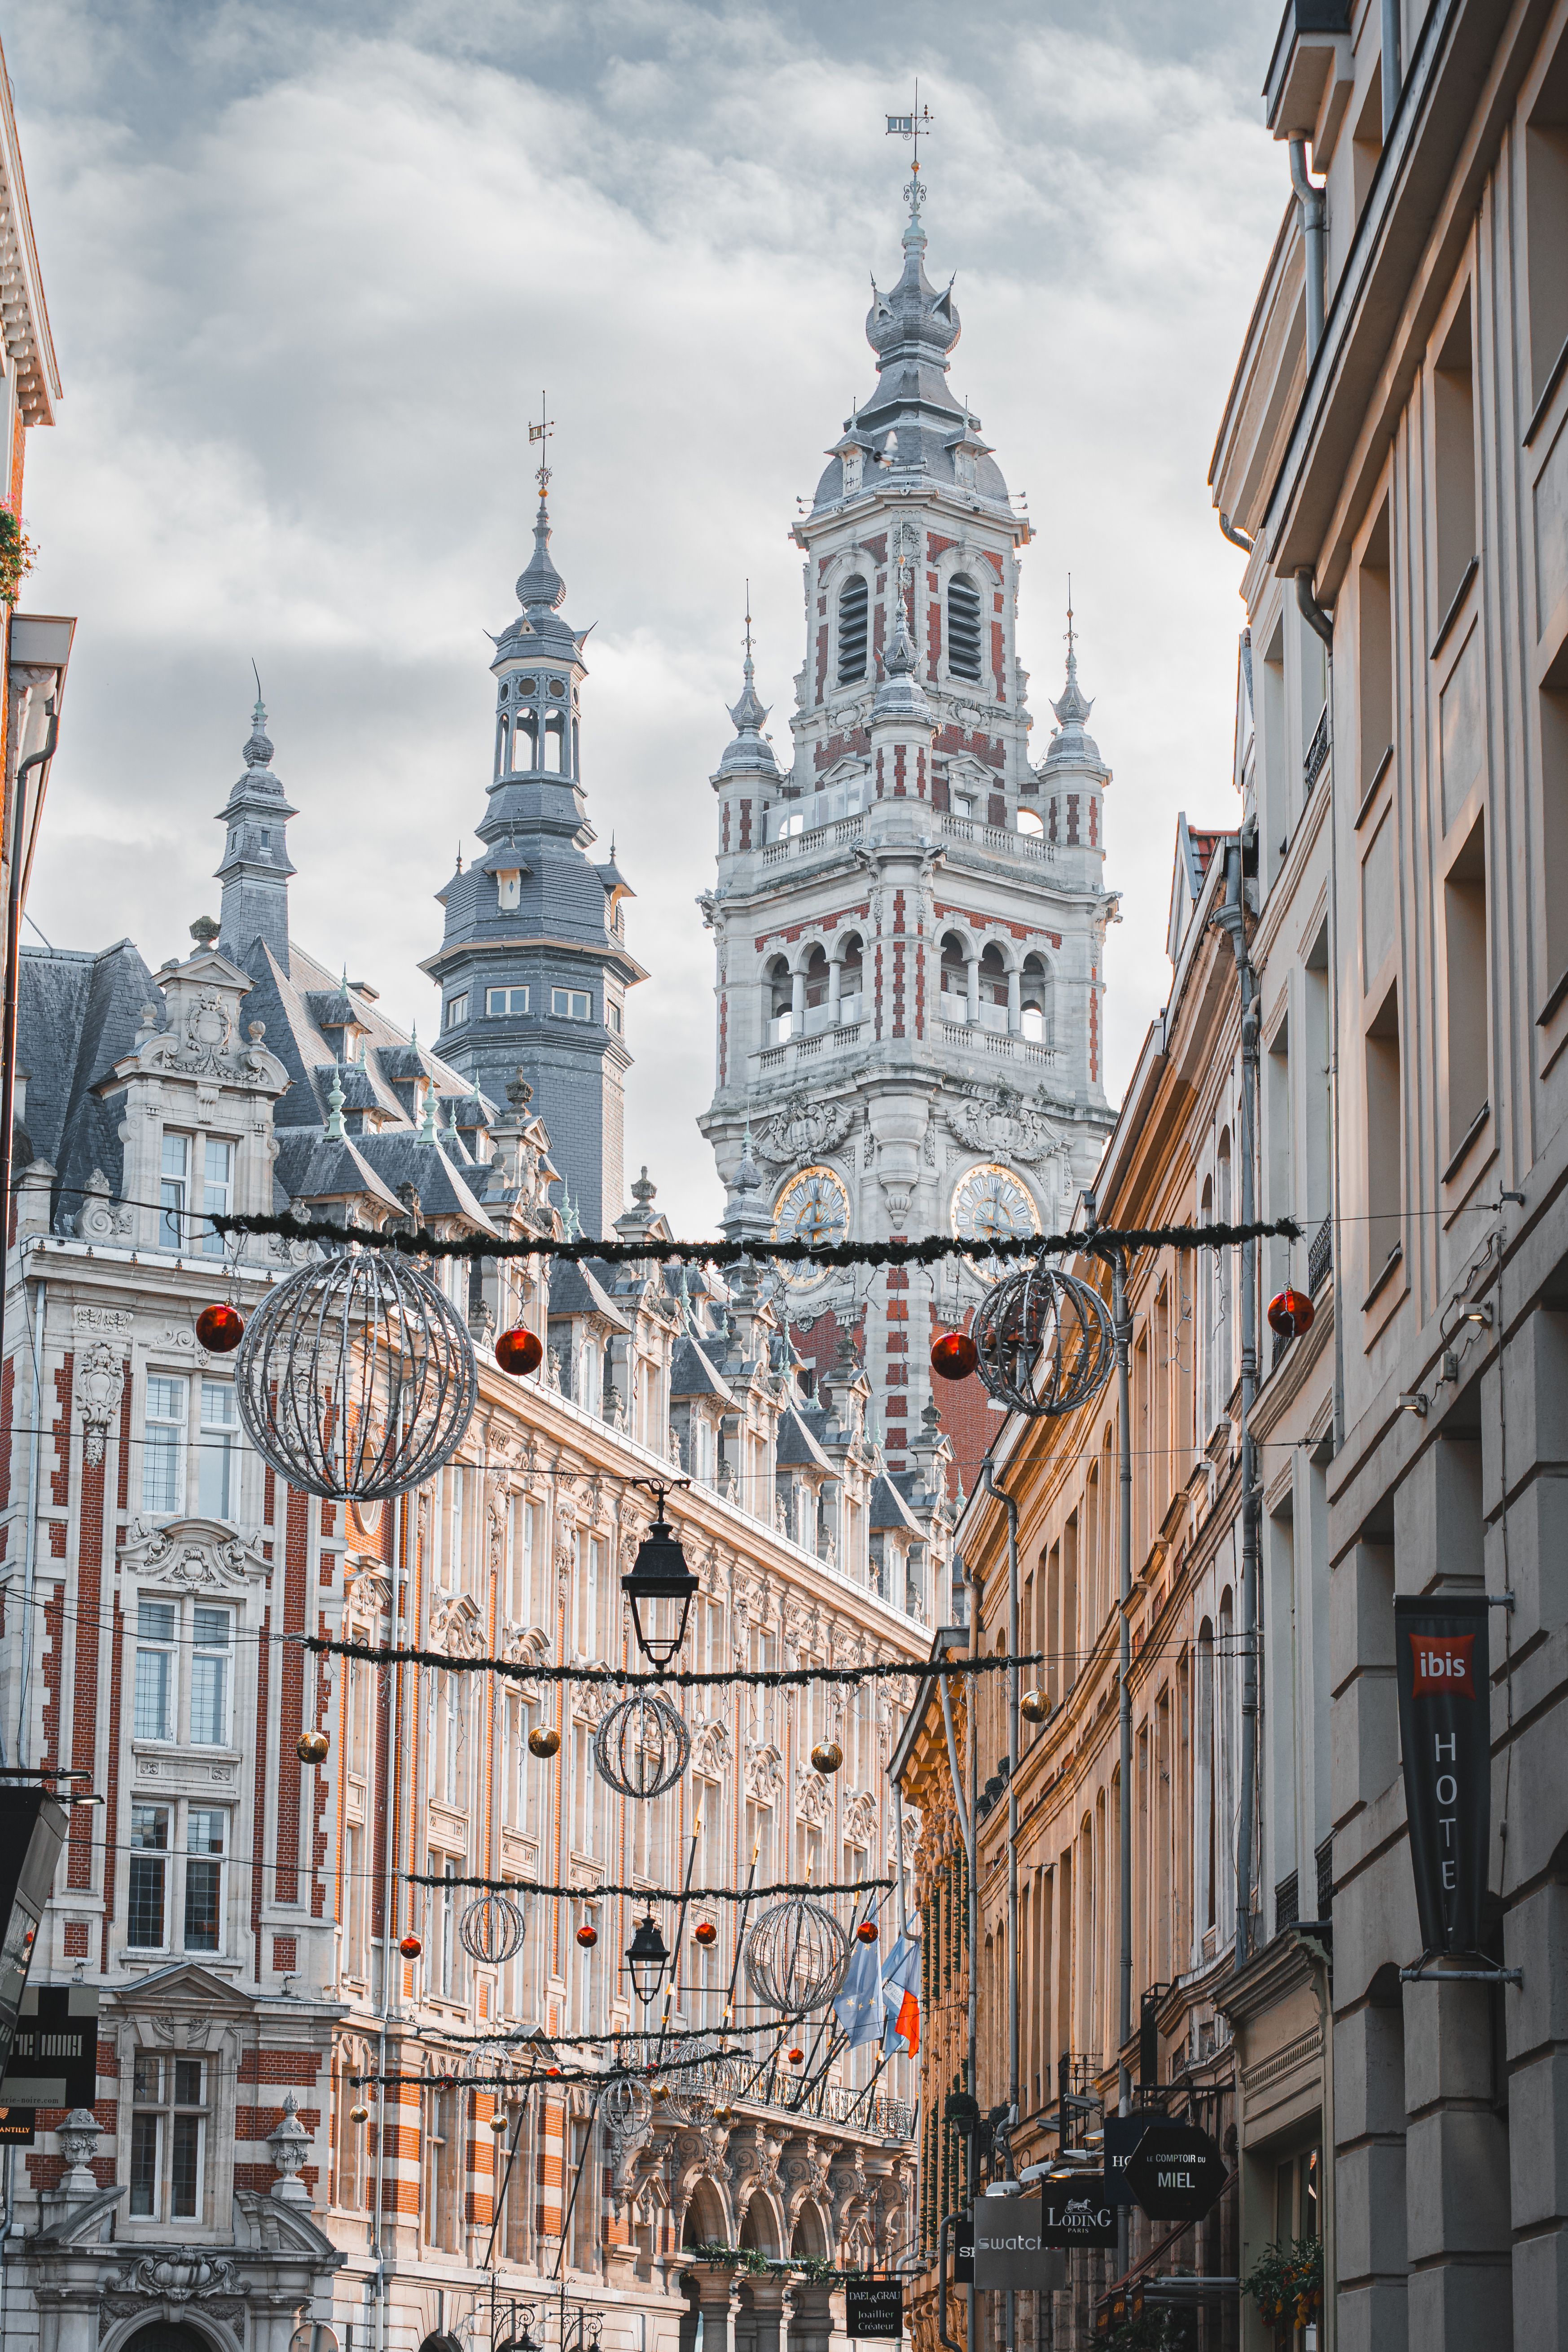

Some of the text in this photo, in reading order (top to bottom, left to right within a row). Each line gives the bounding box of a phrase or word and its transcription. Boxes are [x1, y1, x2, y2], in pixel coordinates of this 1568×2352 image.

[1420, 1652, 1465, 1677] ibis
[1435, 1733, 1457, 1931] HOTE
[1156, 2154, 1195, 2163] COMPTOIR
[1158, 2172, 1195, 2188] MIEL
[1047, 2207, 1112, 2227] LODING
[858, 2310, 894, 2320] Joaillier
[858, 2322, 894, 2330] Créateur
